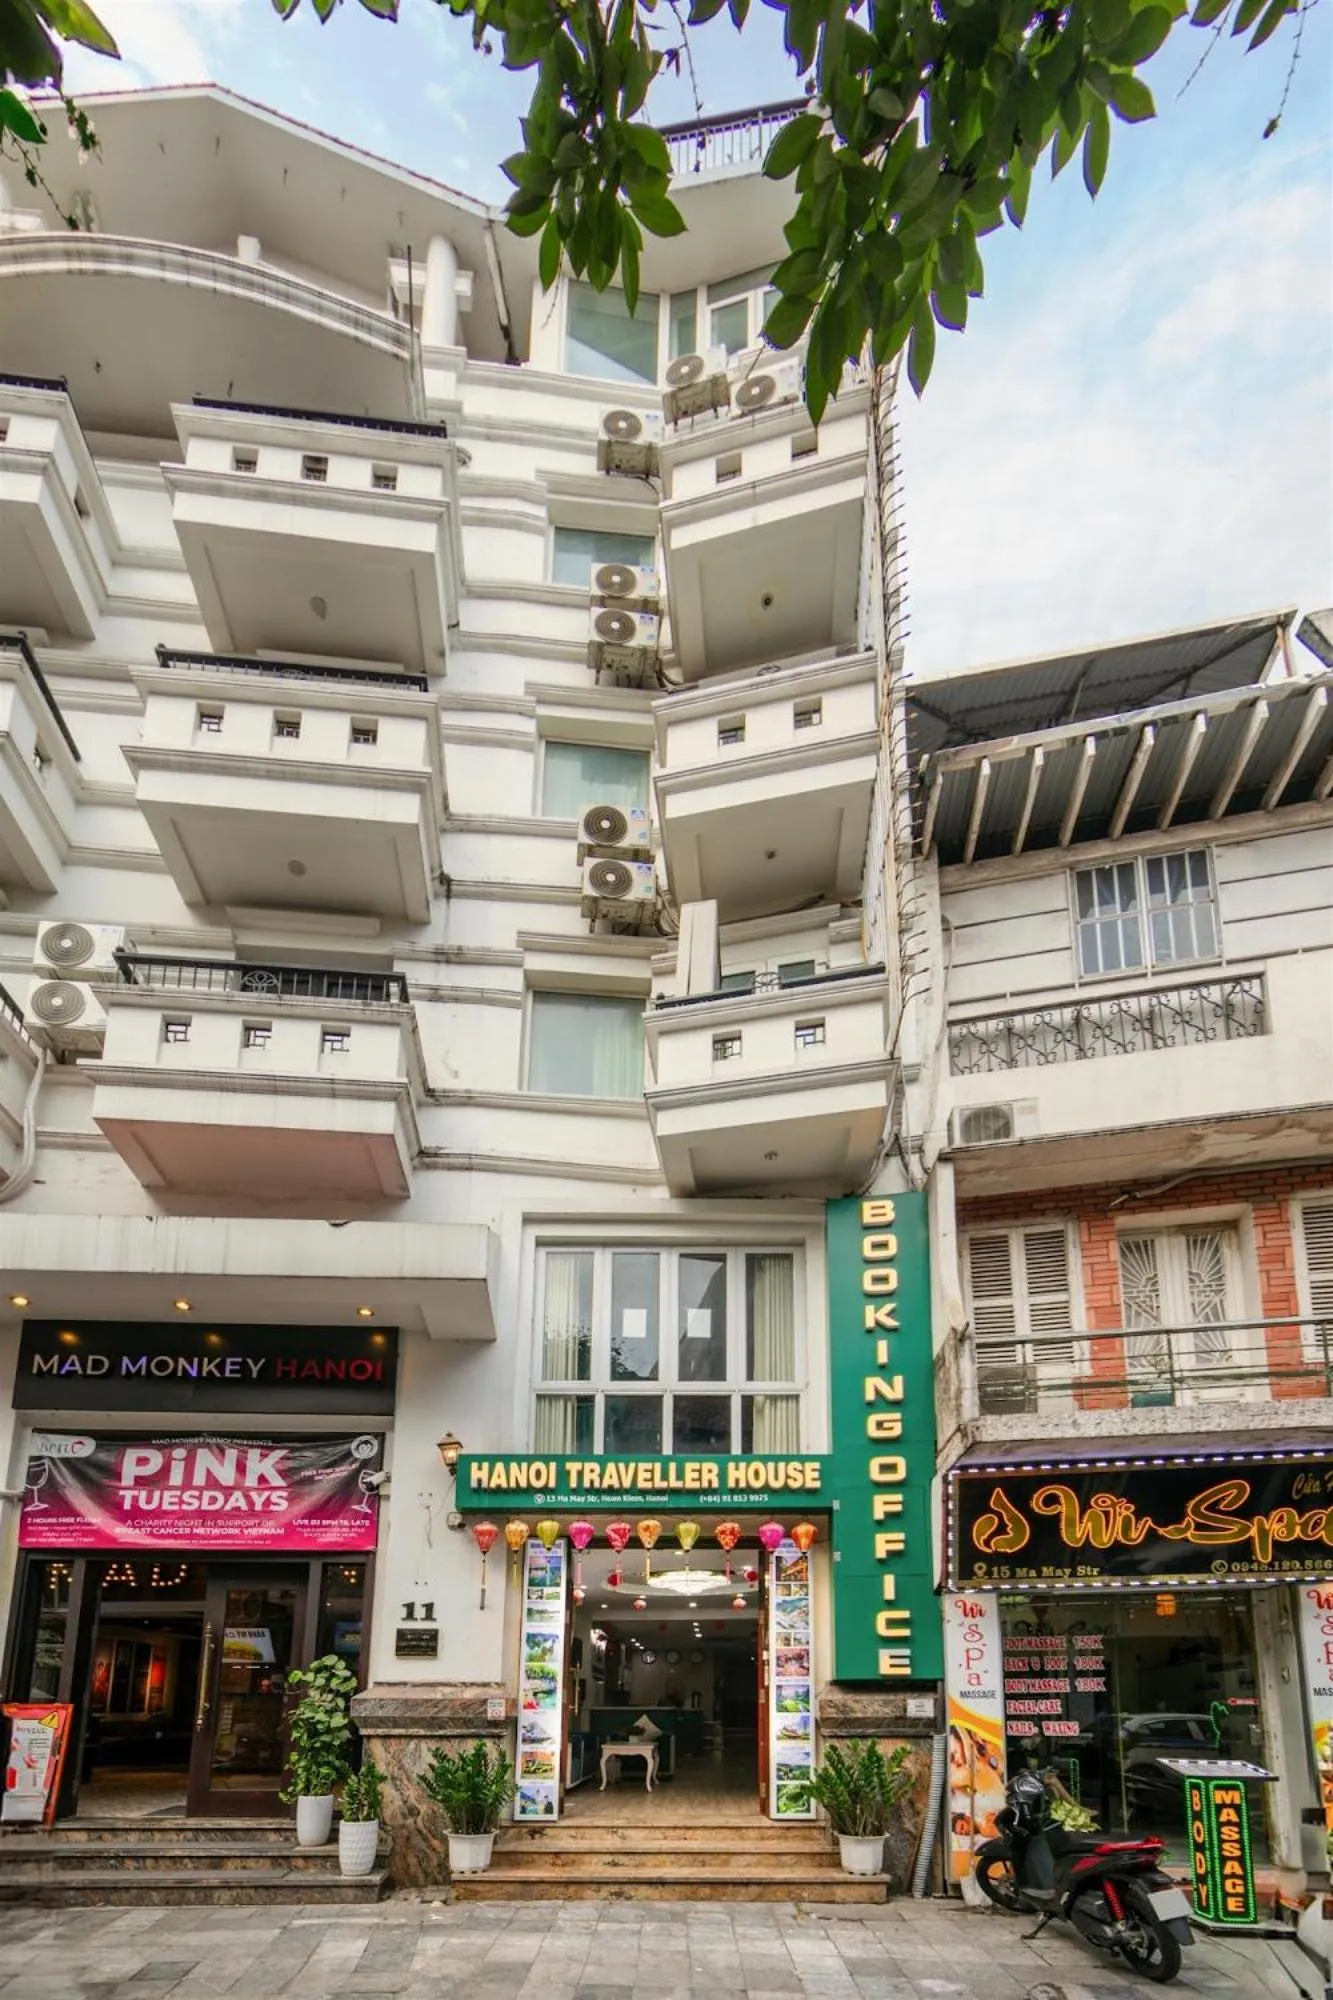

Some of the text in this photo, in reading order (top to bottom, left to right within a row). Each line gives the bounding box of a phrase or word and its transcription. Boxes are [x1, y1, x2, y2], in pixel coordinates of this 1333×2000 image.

[31, 1353, 383, 1381] MAD MONKEY HANOI
[861, 1199, 912, 1676] BOOKING OFFICE
[469, 1461, 822, 1490] HANOI TRAVELLER HOUSE
[118, 1489, 289, 1512] TUESDAYS
[126, 1519, 133, 1527] A
[134, 1519, 173, 1528] CHARITY
[175, 1519, 203, 1528] NIGHT
[216, 1519, 260, 1528] SUPPORT
[153, 1527, 192, 1536] CANCER
[193, 1527, 241, 1536] NETWORK
[242, 1527, 284, 1536] VIETNAM
[1030, 1478, 1333, 1564] Wi Spa
[990, 1564, 1100, 1579] 15 Ma May Str
[400, 1601, 438, 1622] 11
[1024, 1635, 1066, 1649] MASSAGE
[959, 1689, 998, 1700] MASSAGE
[1028, 1678, 1070, 1693] MASSAGE
[1006, 1699, 1062, 1714] FACIAL CARE
[1191, 1788, 1208, 1907] BODY
[1213, 1788, 1246, 1913] MASSAGE
